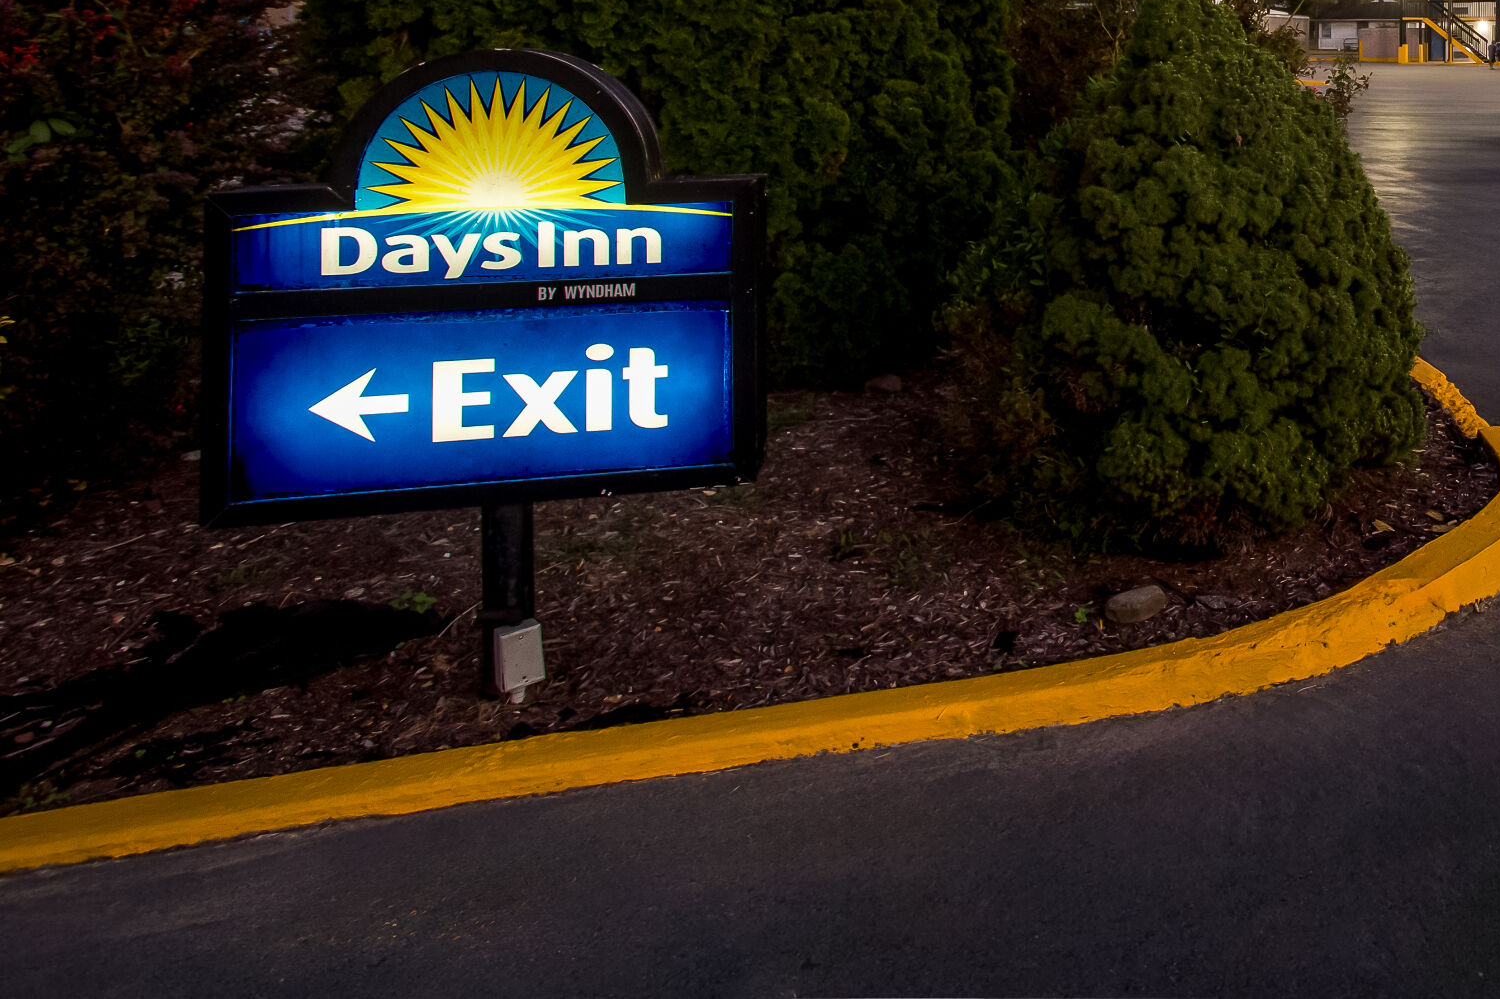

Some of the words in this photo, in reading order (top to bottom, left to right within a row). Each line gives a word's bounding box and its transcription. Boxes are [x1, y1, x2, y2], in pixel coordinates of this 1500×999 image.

[320, 226, 522, 279] Days
[537, 220, 662, 268] Inn
[537, 286, 557, 301] BY
[564, 283, 636, 300] WYNDHAM
[431, 343, 669, 443] Exit
